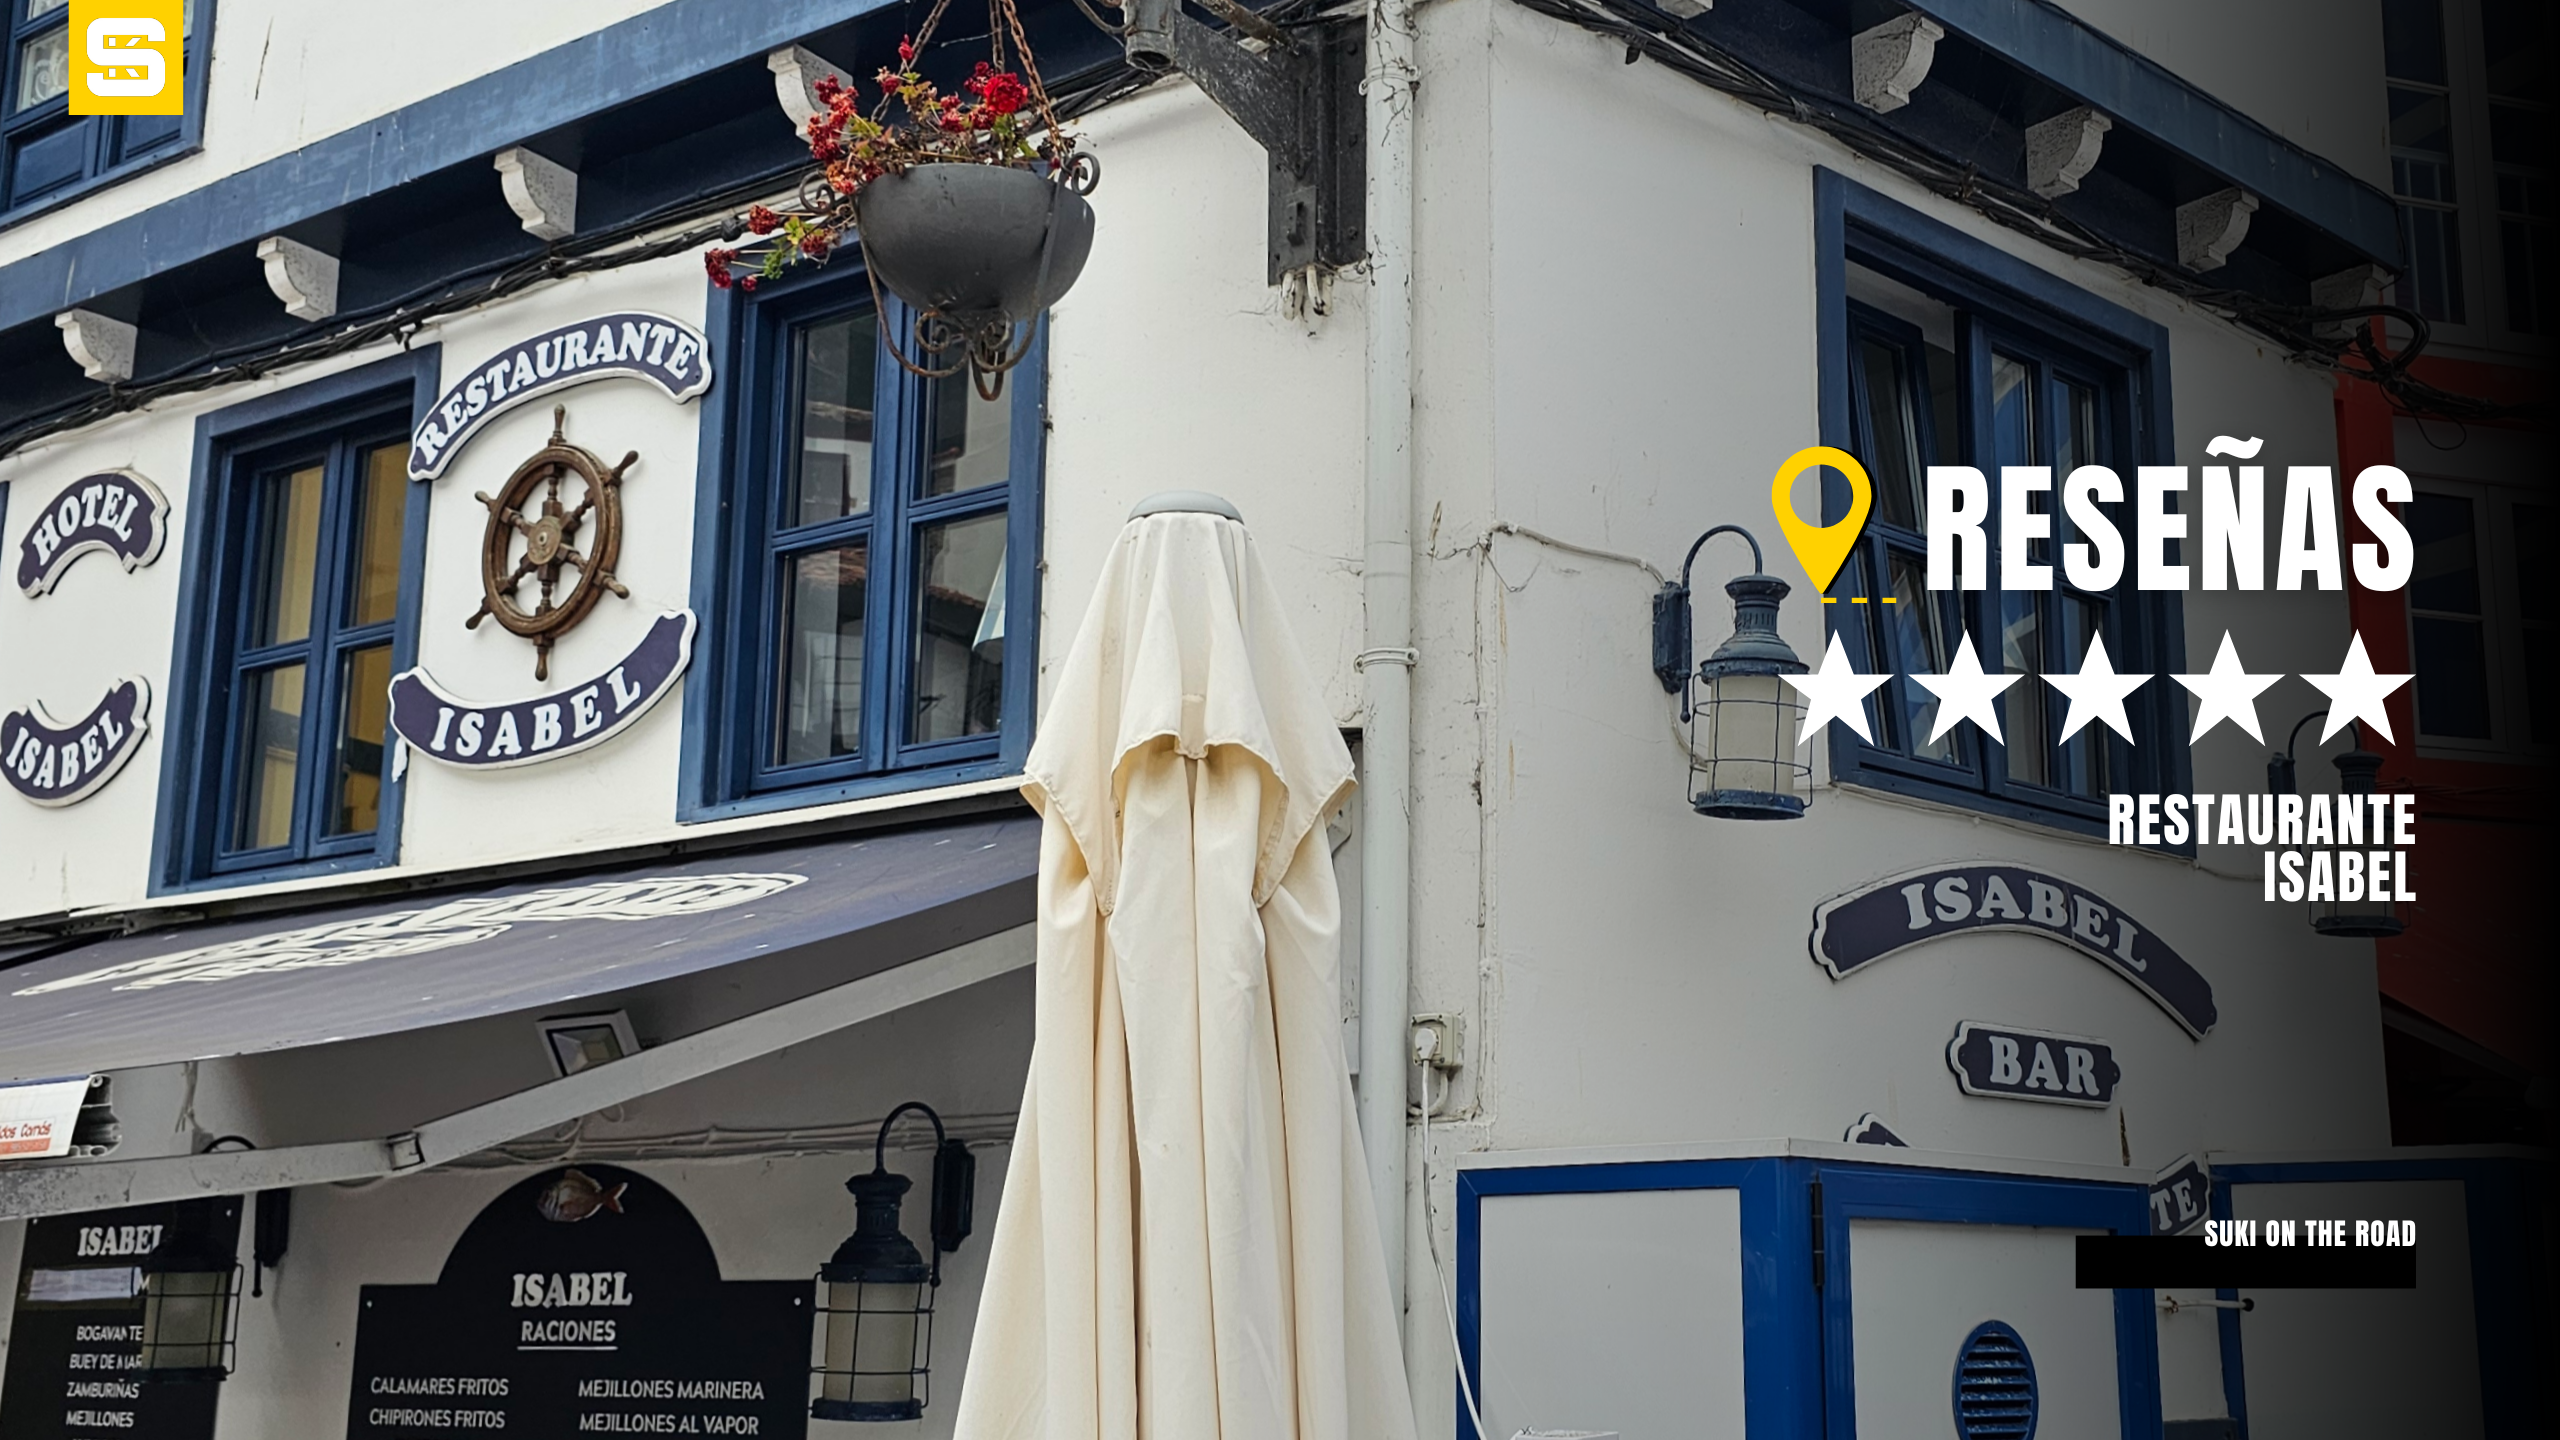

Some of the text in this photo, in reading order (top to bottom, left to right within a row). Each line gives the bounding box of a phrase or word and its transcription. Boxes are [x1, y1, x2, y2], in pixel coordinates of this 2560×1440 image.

[416, 322, 699, 465] RESTAURANTE
[33, 484, 139, 566] HOTEL
[430, 666, 641, 757] ISABEL
[6, 710, 124, 789] ISABEL
[1901, 875, 2148, 973] ISABEL
[1990, 1036, 2099, 1095] BAR
[511, 1272, 632, 1308] ISABEL
[521, 1320, 616, 1342] RACIONES
[69, 1354, 99, 1369] BUEY
[100, 1354, 116, 1369] DE
[66, 1379, 140, 1398] ZAMBURIÑAS
[371, 1377, 509, 1396] CALAMARES FRITOS
[578, 1380, 764, 1400] MEJILLONES MARINERA
[66, 1409, 135, 1427] MEJILLONES
[370, 1408, 505, 1428] CHIPIRONES FRITOS
[579, 1413, 759, 1435] MEJILLONES AL VAPOR
